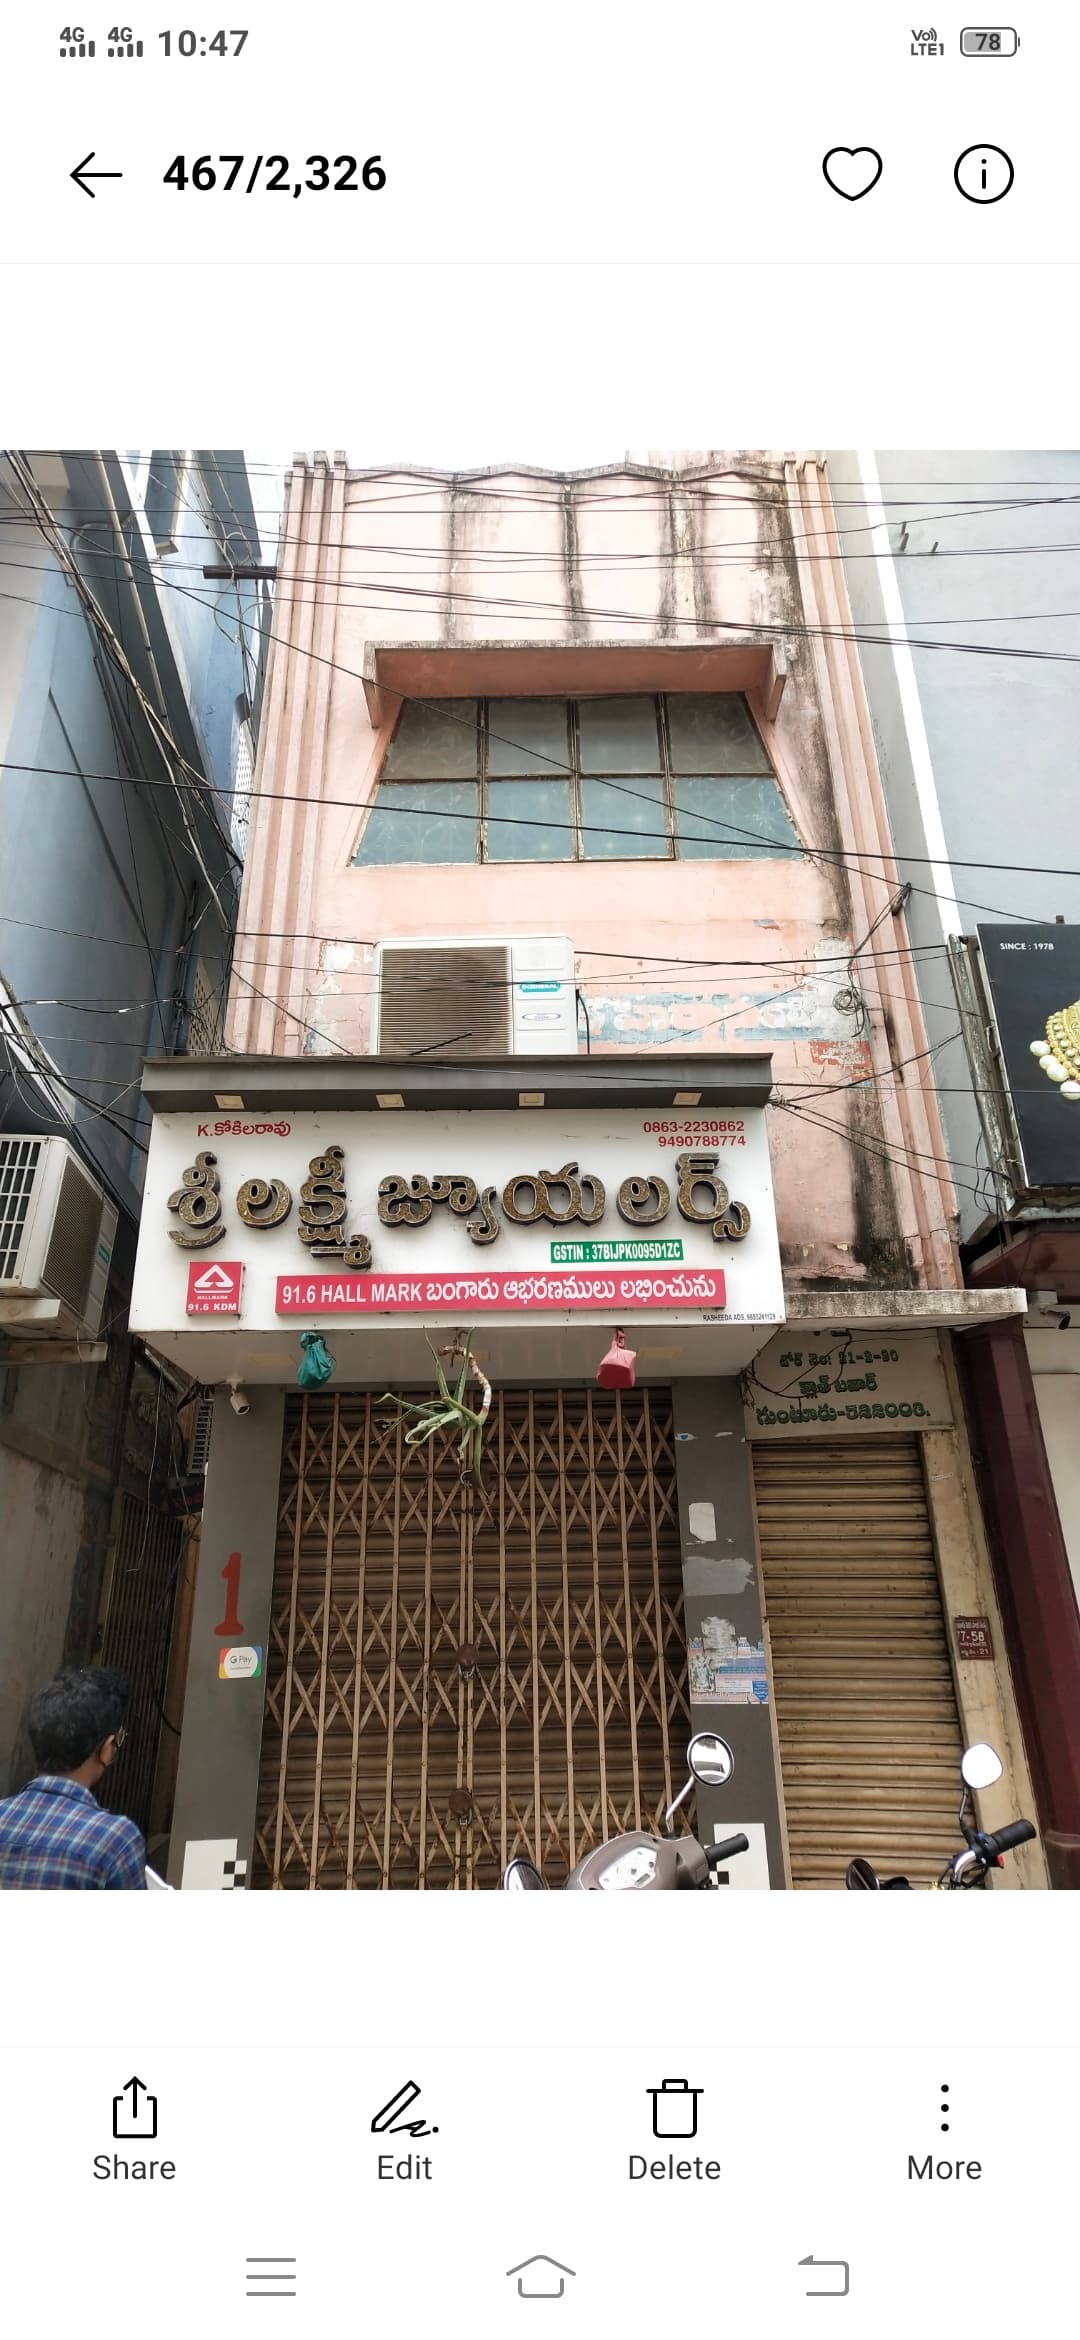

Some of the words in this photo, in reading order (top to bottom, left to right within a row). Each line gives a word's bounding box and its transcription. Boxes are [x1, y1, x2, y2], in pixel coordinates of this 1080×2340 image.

[999, 942, 1027, 951] SINCE
[1033, 942, 1055, 951] 1978
[643, 1120, 745, 1133] 0863-2230862
[658, 1134, 747, 1148] 9490788774
[167, 1150, 227, 1249] శ్రీ
[553, 1243, 584, 1260] GSTIN
[282, 1284, 316, 1304] 91.6
[320, 1284, 367, 1303] HALL
[371, 1281, 424, 1303] MARK
[426, 1278, 500, 1302] బంగారు
[502, 1274, 616, 1305] ఆభరణములు
[619, 1272, 718, 1303] లభించును
[187, 1303, 210, 1311] 91.6
[213, 1303, 238, 1311] KDM
[213, 1551, 245, 1637] 1
